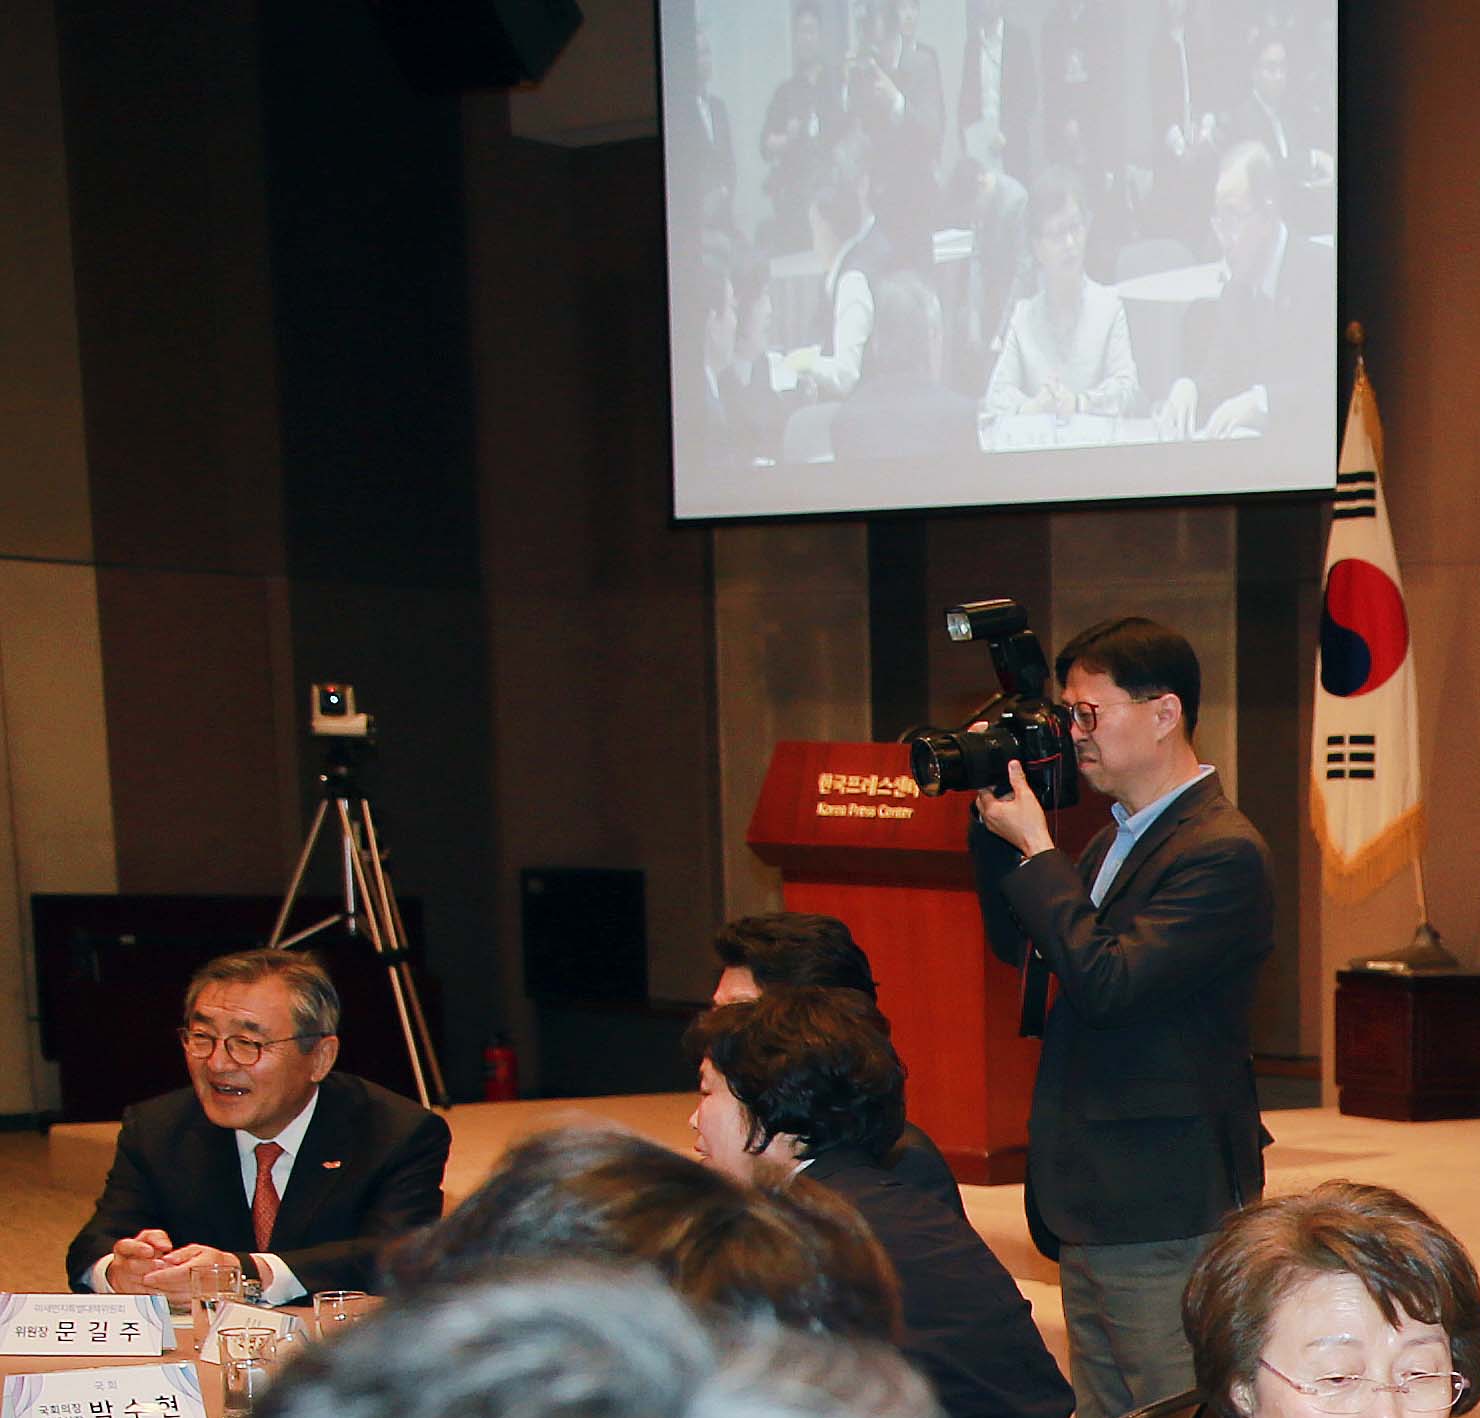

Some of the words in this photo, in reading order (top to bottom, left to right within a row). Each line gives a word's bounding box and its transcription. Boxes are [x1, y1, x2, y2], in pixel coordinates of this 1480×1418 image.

[817, 802, 847, 817] Korea
[848, 802, 877, 818] Press
[878, 803, 914, 819] Center
[15, 1325, 49, 1339] 위원장
